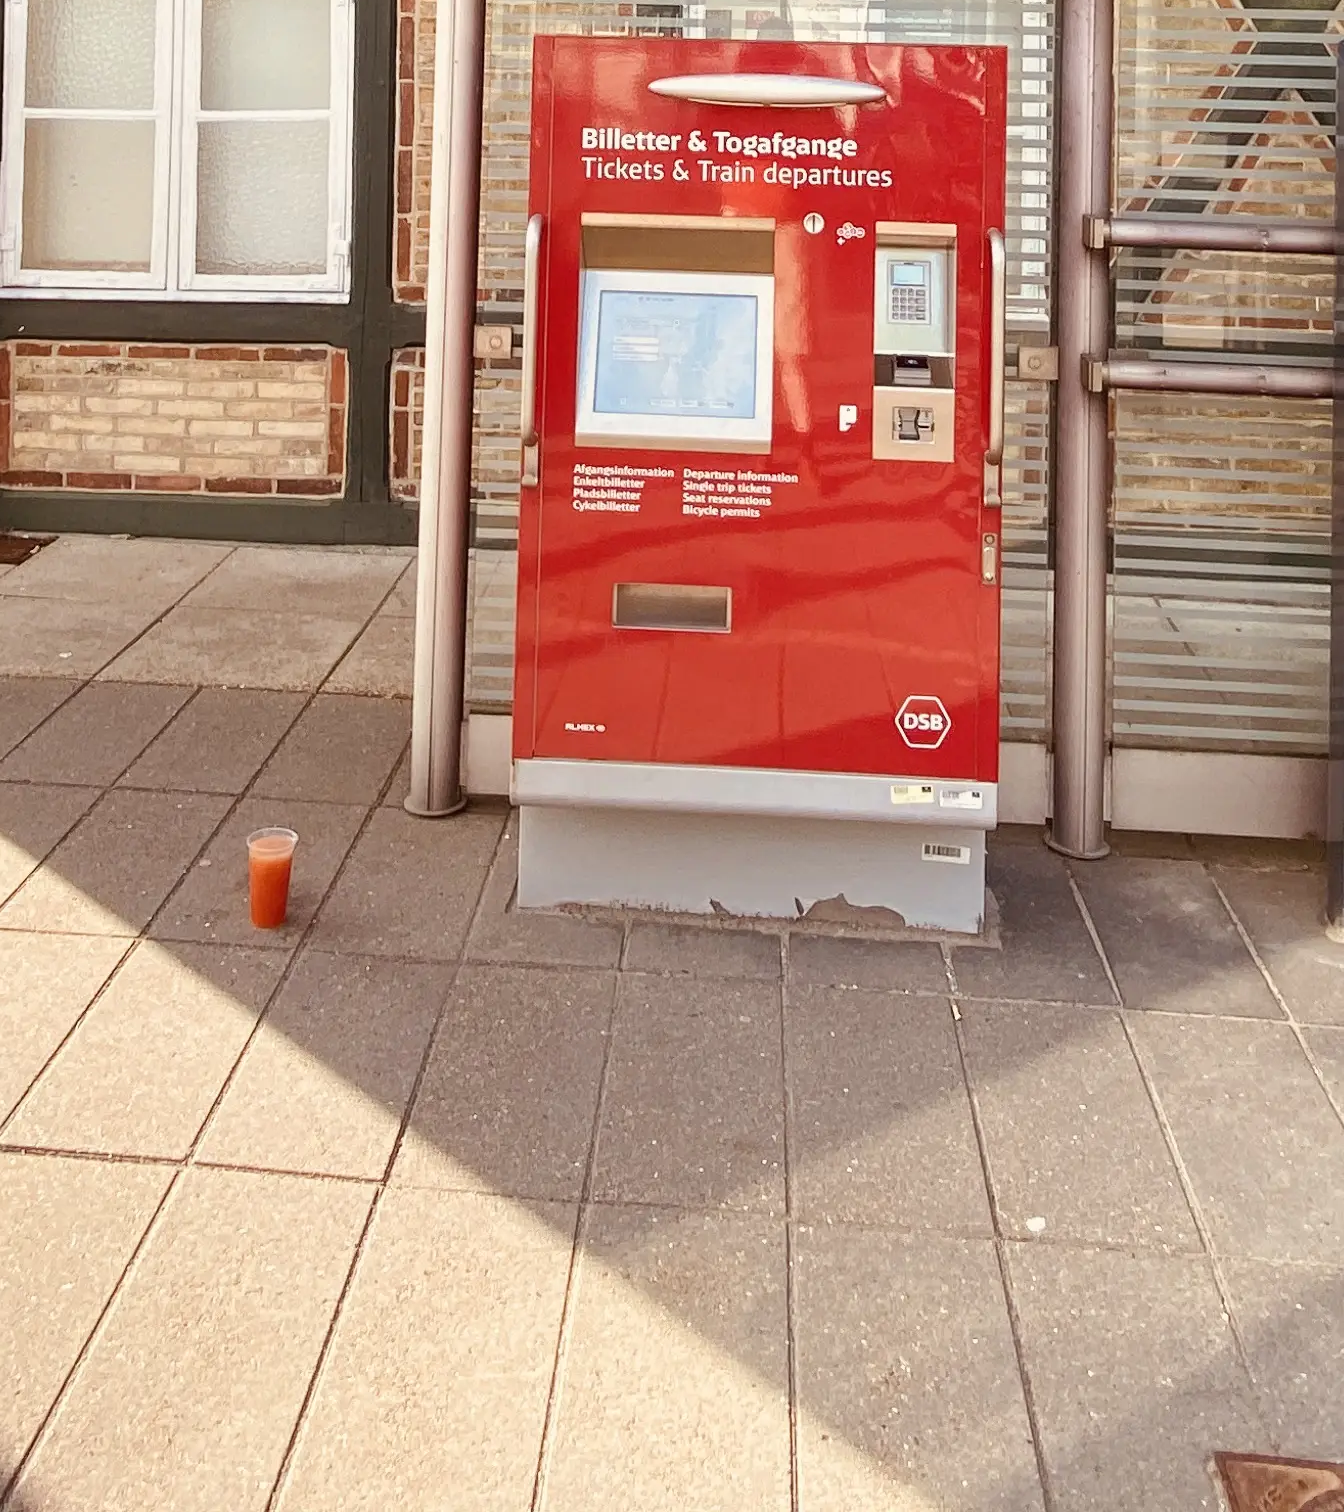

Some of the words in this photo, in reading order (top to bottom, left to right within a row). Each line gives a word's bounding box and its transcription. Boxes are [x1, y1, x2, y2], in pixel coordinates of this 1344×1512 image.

[581, 127, 682, 152] Billetter
[687, 130, 707, 152] &
[712, 131, 858, 160] Togafgange
[581, 156, 665, 181] Tickets
[672, 159, 690, 182] &
[697, 160, 755, 183] Train
[763, 162, 893, 189] departures
[573, 464, 675, 478] Afgangsinformation
[683, 468, 736, 480] Departure
[737, 470, 798, 483] information
[682, 480, 715, 492] Single
[717, 483, 736, 494] trip
[738, 482, 772, 494] tickets
[682, 492, 706, 503] Seat
[708, 495, 772, 506] reservations
[682, 504, 719, 517] Bicycle
[720, 507, 761, 518] permits
[903, 713, 944, 731] DSB
